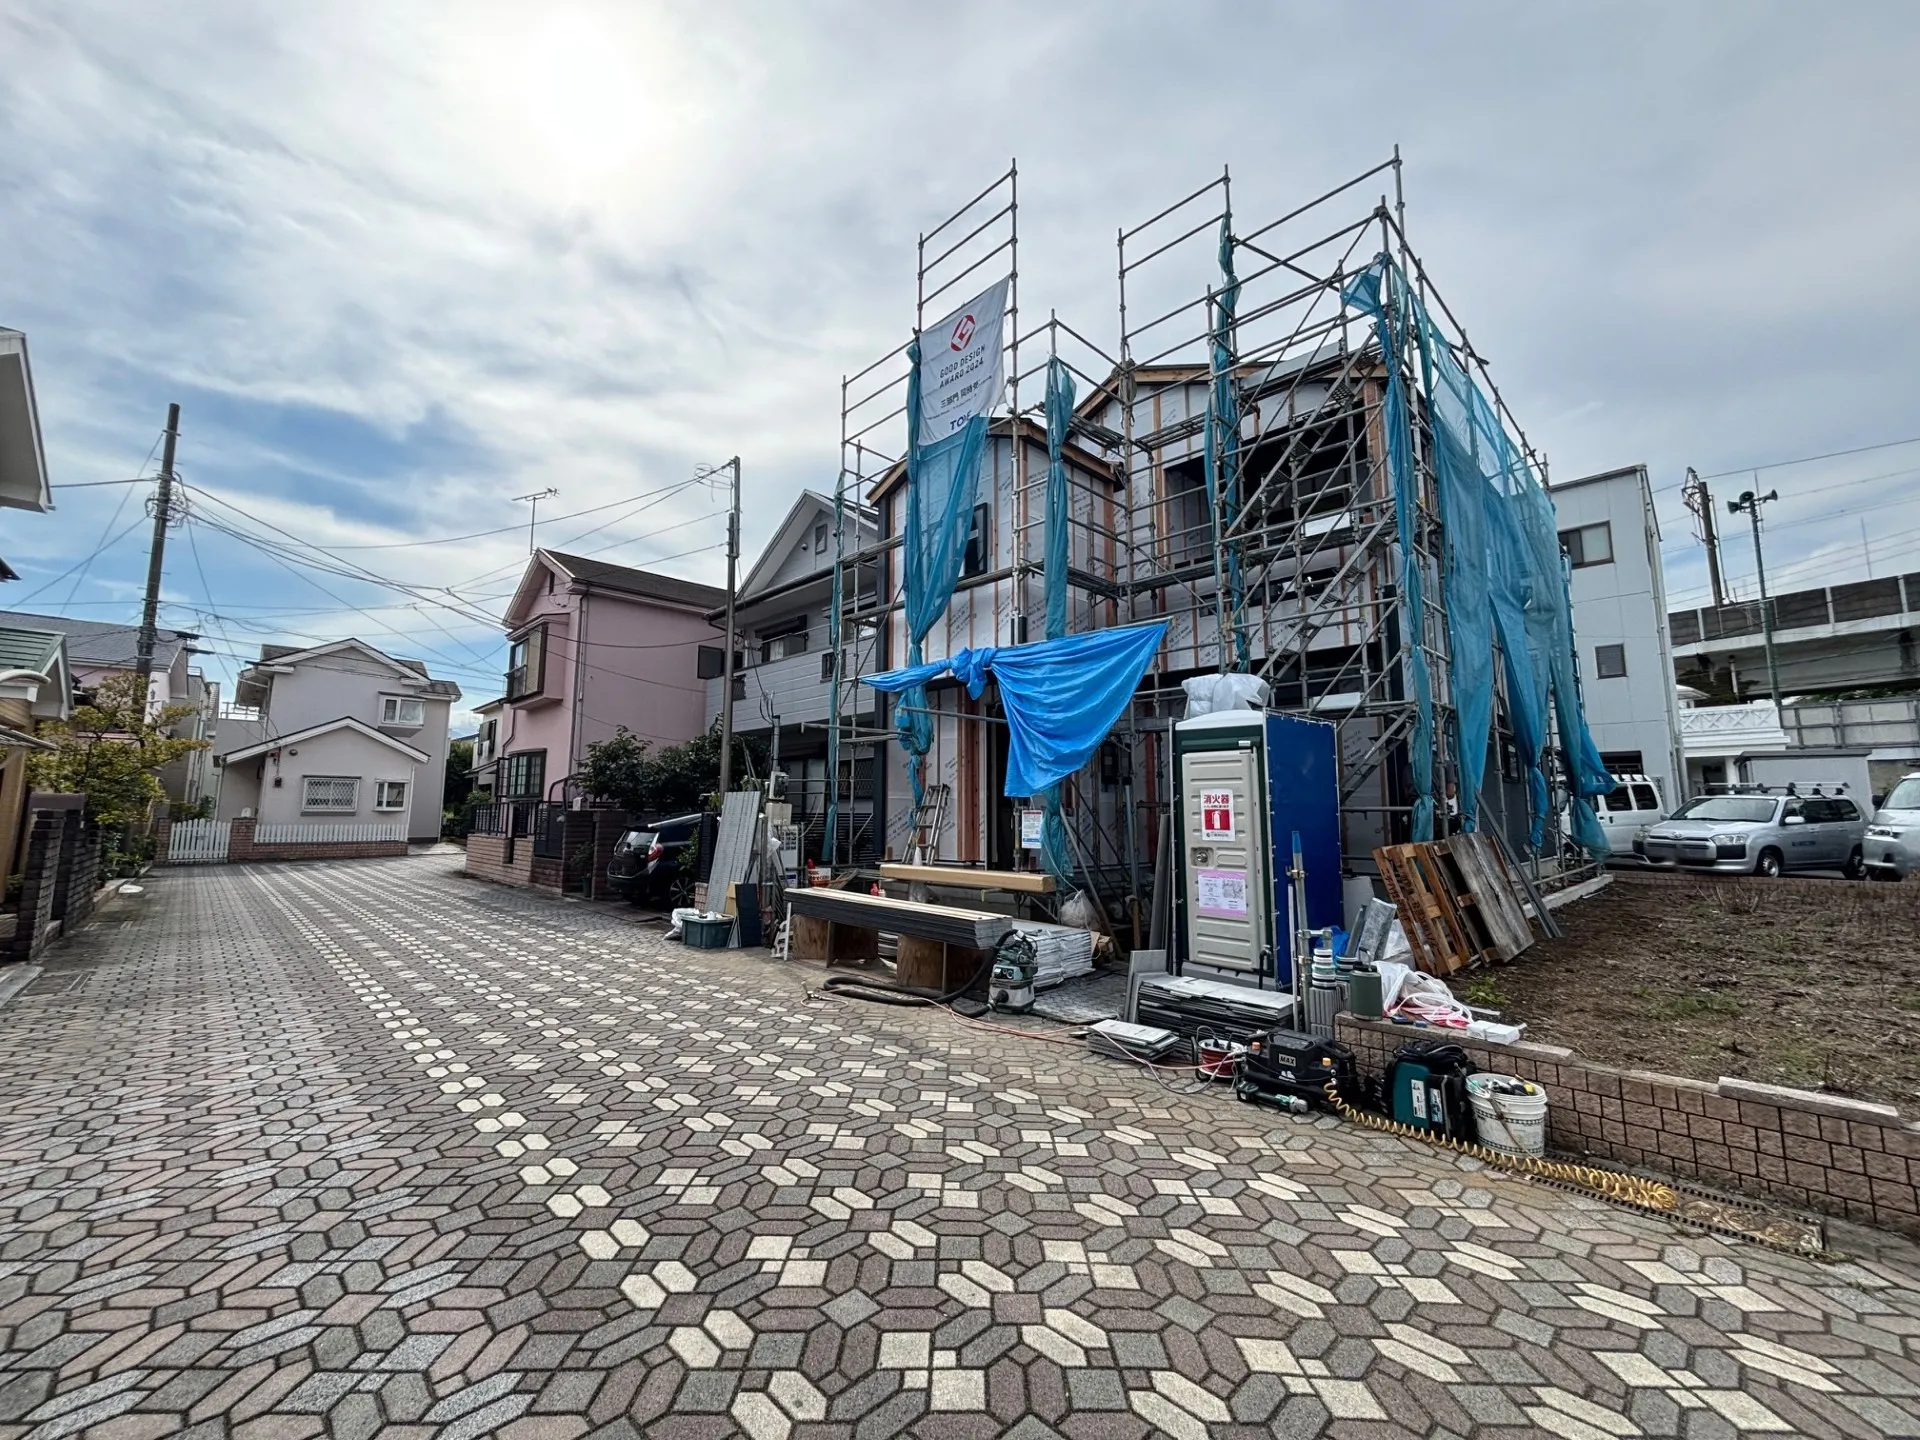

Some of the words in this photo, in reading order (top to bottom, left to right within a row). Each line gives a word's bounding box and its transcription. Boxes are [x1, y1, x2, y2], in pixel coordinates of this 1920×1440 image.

[940, 361, 958, 379] GOOD
[960, 344, 986, 367] DESIGN
[940, 369, 964, 389] AWARD
[965, 356, 984, 374] 2024
[1203, 794, 1230, 805] 消火器
[1280, 1055, 1295, 1064] MAX
